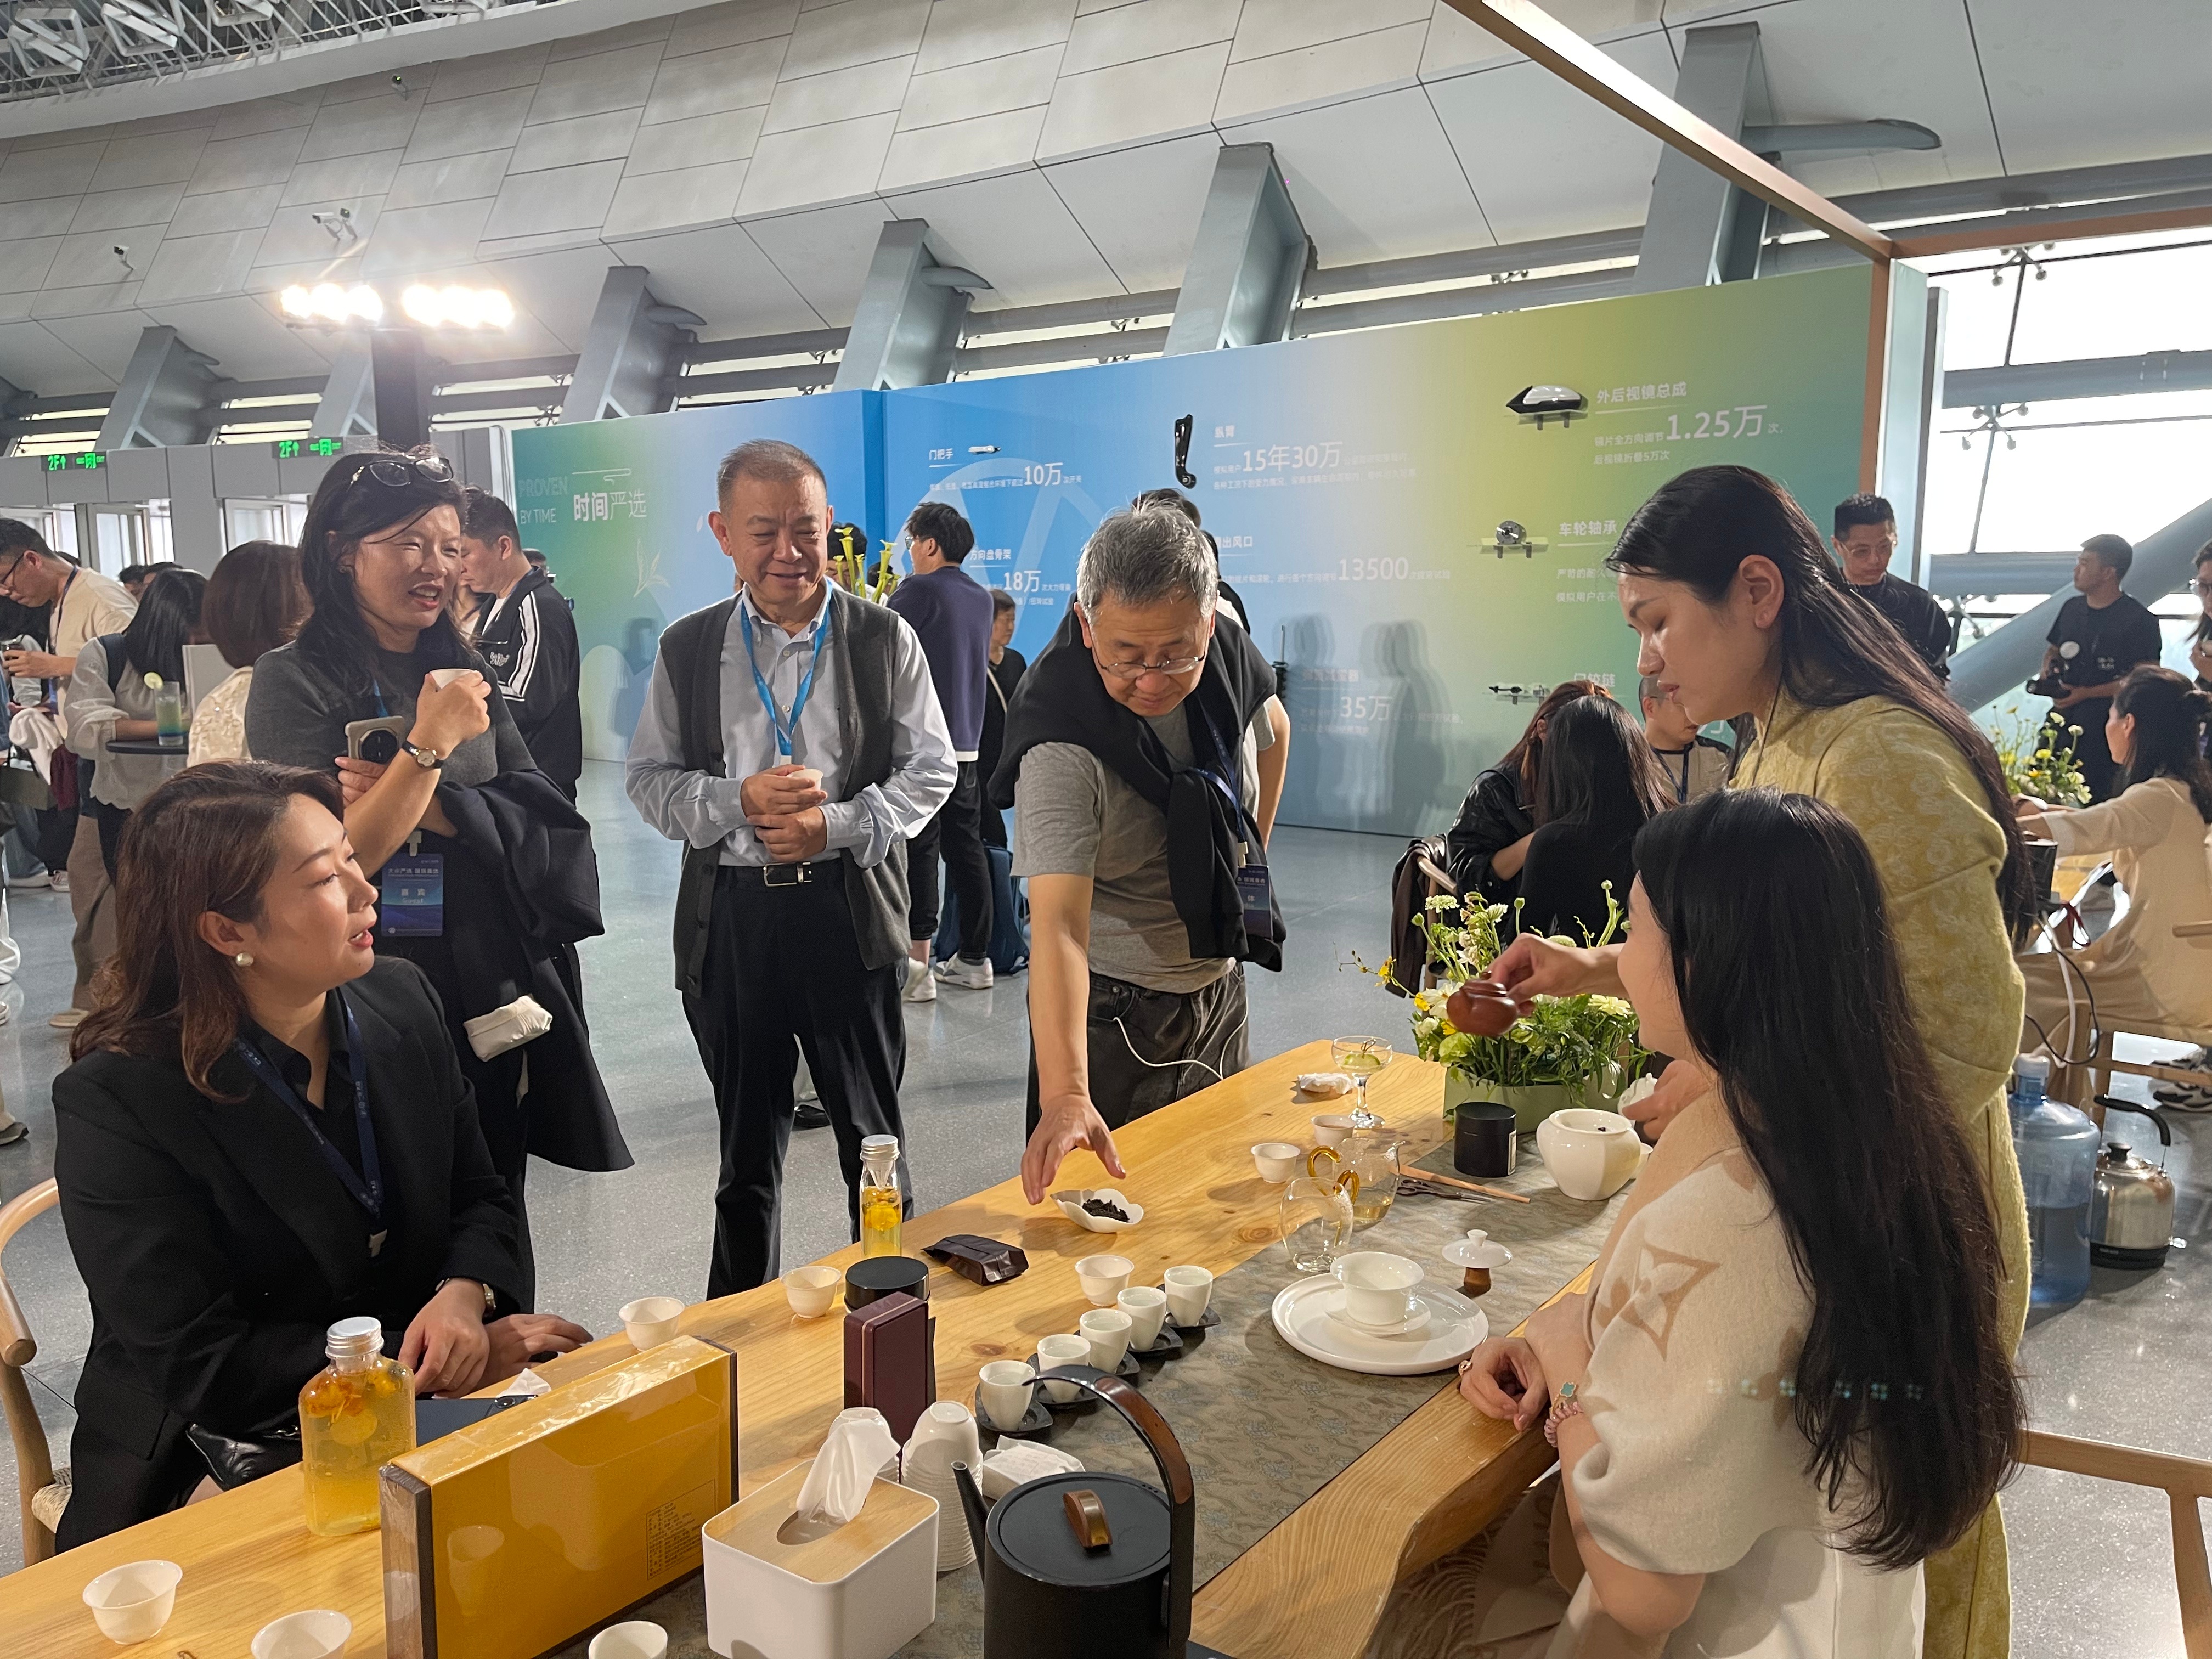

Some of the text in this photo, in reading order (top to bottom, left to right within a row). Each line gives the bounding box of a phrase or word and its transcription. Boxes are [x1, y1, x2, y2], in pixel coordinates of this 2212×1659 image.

[1596, 381, 1687, 404] 外后视镜总成
[1667, 405, 1767, 441] 1.25万
[48, 455, 60, 471] 2F
[929, 448, 953, 460] 门把手
[1243, 441, 1343, 472] 15年30万
[1024, 462, 1063, 486] 10万
[518, 476, 568, 498] PROVEN
[573, 488, 647, 521] 时间严选
[520, 508, 557, 524] BY TIME
[1559, 520, 1617, 536] 车轮轴承
[969, 549, 1011, 560] 方向盘骨架
[1338, 557, 1409, 582] 13500
[1556, 568, 1616, 579] 严苛的耐久
[1003, 570, 1041, 592] 18万
[1340, 696, 1393, 721] 35万
